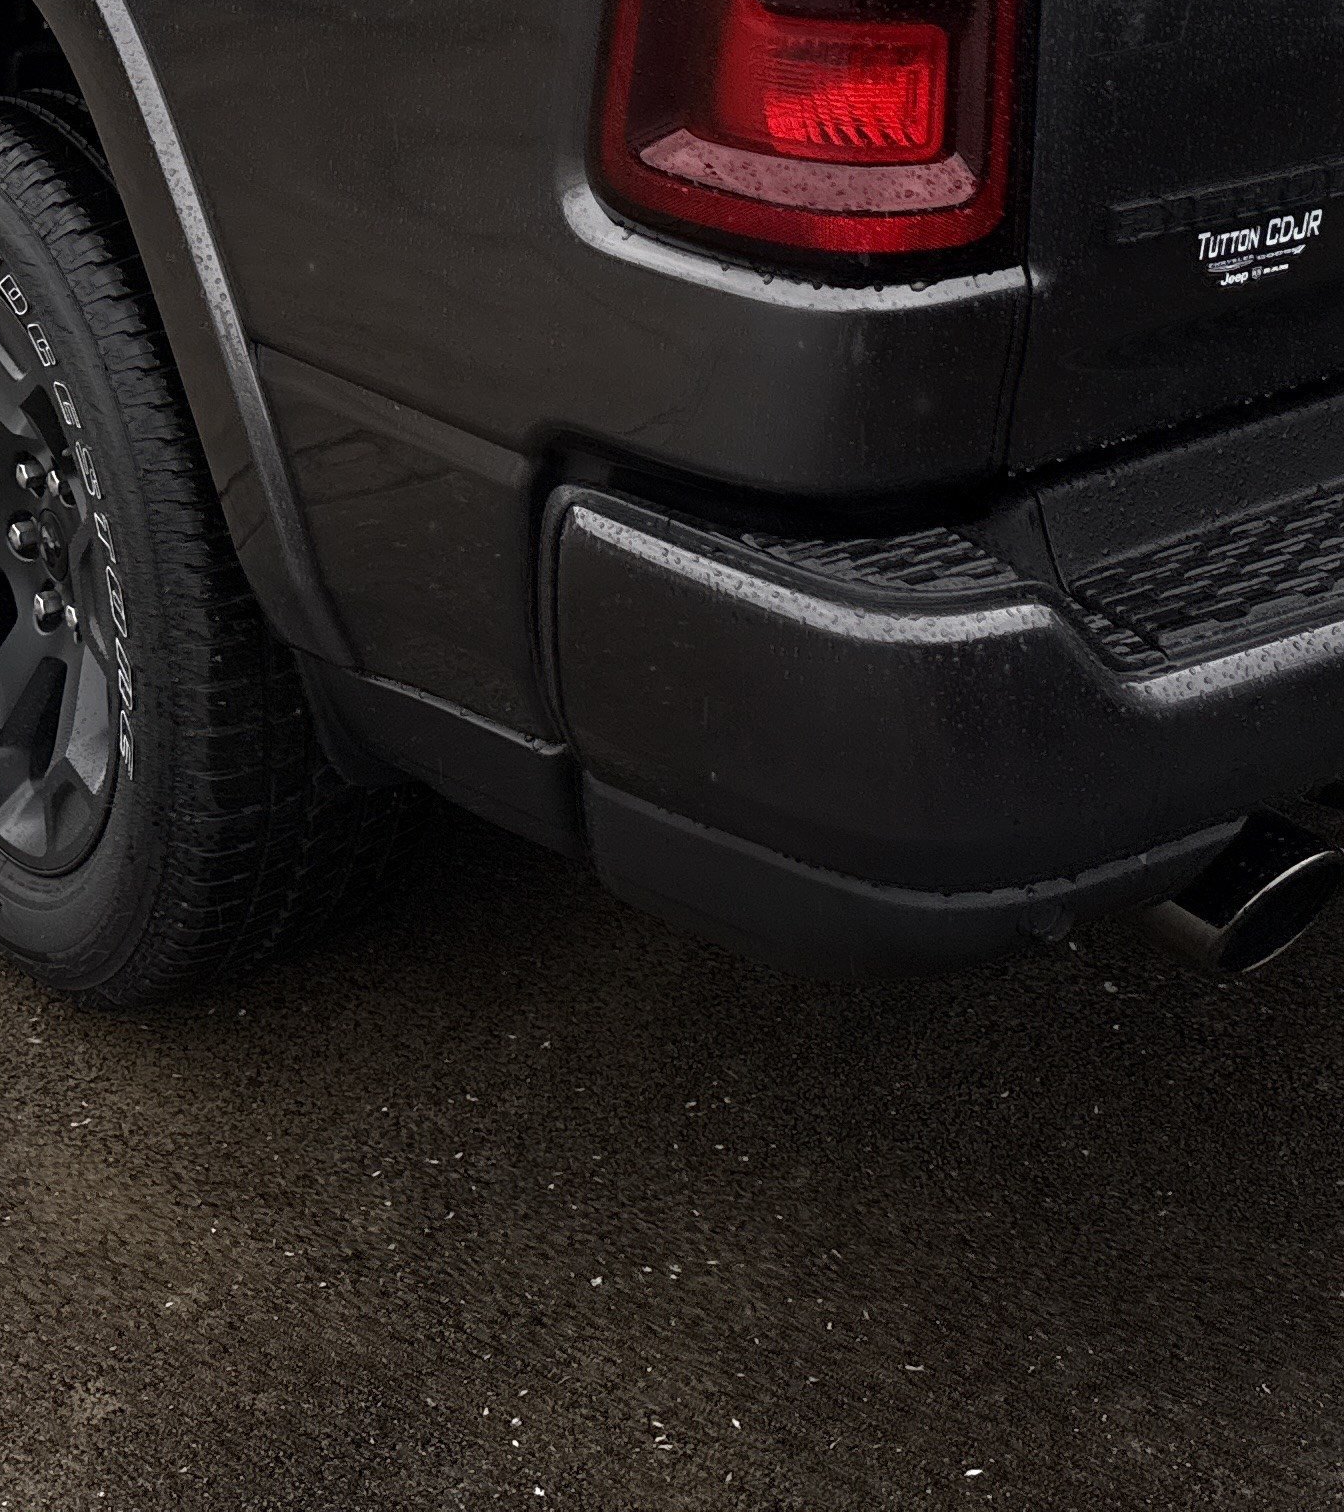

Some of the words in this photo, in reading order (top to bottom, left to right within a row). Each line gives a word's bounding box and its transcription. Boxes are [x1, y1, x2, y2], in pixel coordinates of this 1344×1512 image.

[1198, 226, 1261, 260] TUTTON
[1265, 208, 1323, 246] CDJR
[1220, 271, 1249, 286] Jeep
